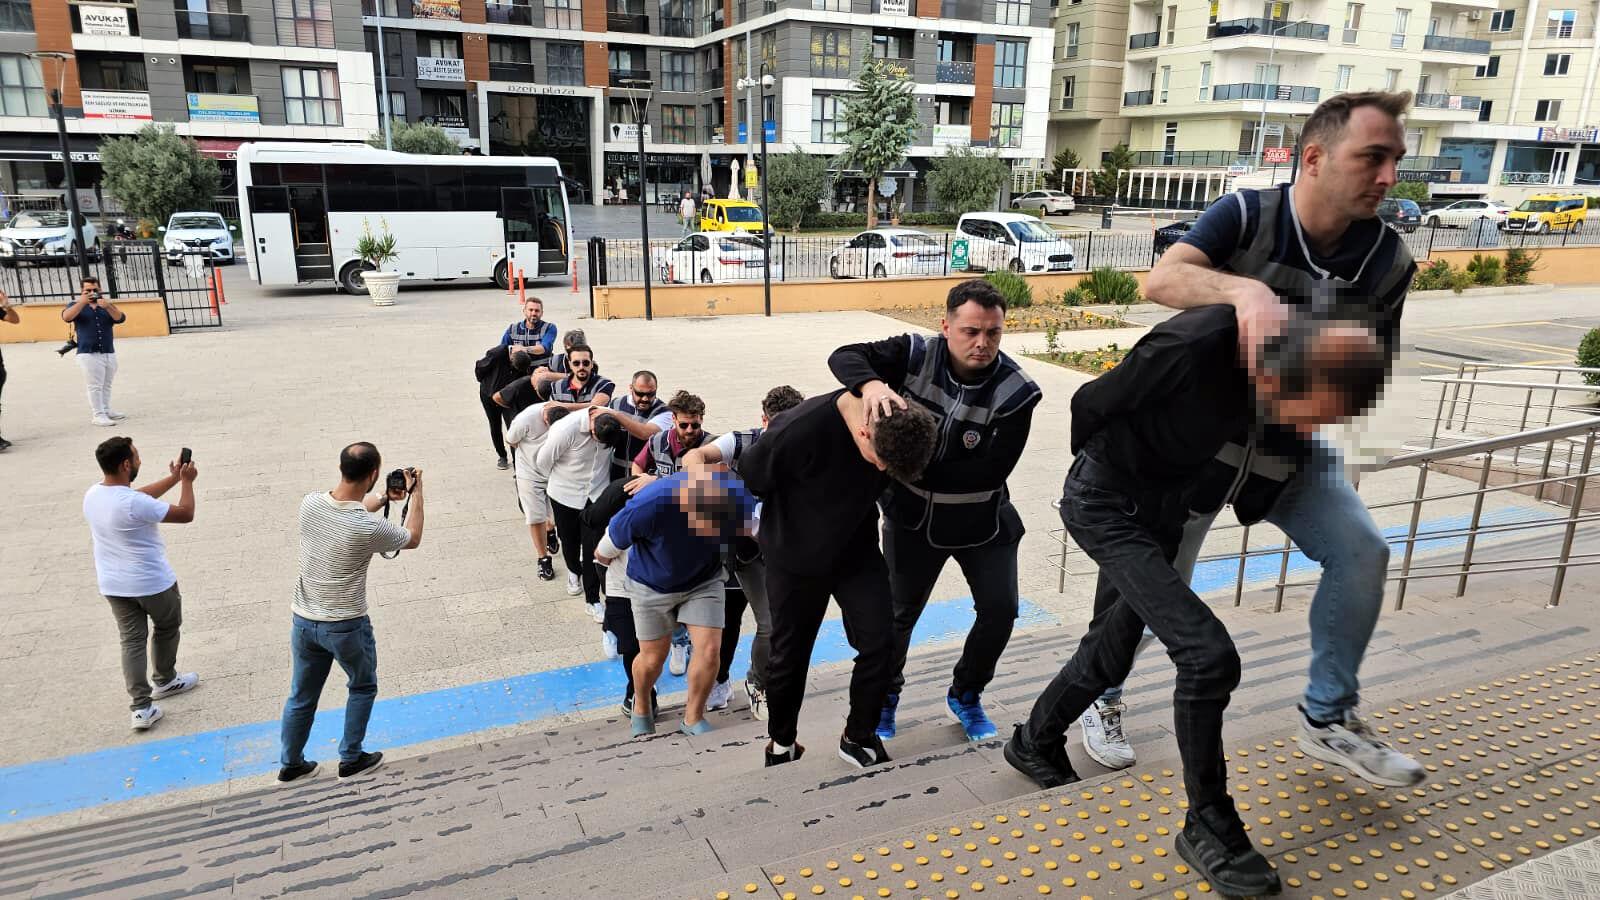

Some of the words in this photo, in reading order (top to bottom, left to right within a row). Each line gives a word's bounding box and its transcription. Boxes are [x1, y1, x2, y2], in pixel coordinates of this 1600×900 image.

[85, 14, 125, 23] AVUKAT
[435, 59, 460, 67] AVUKAT
[542, 86, 575, 95] plaza
